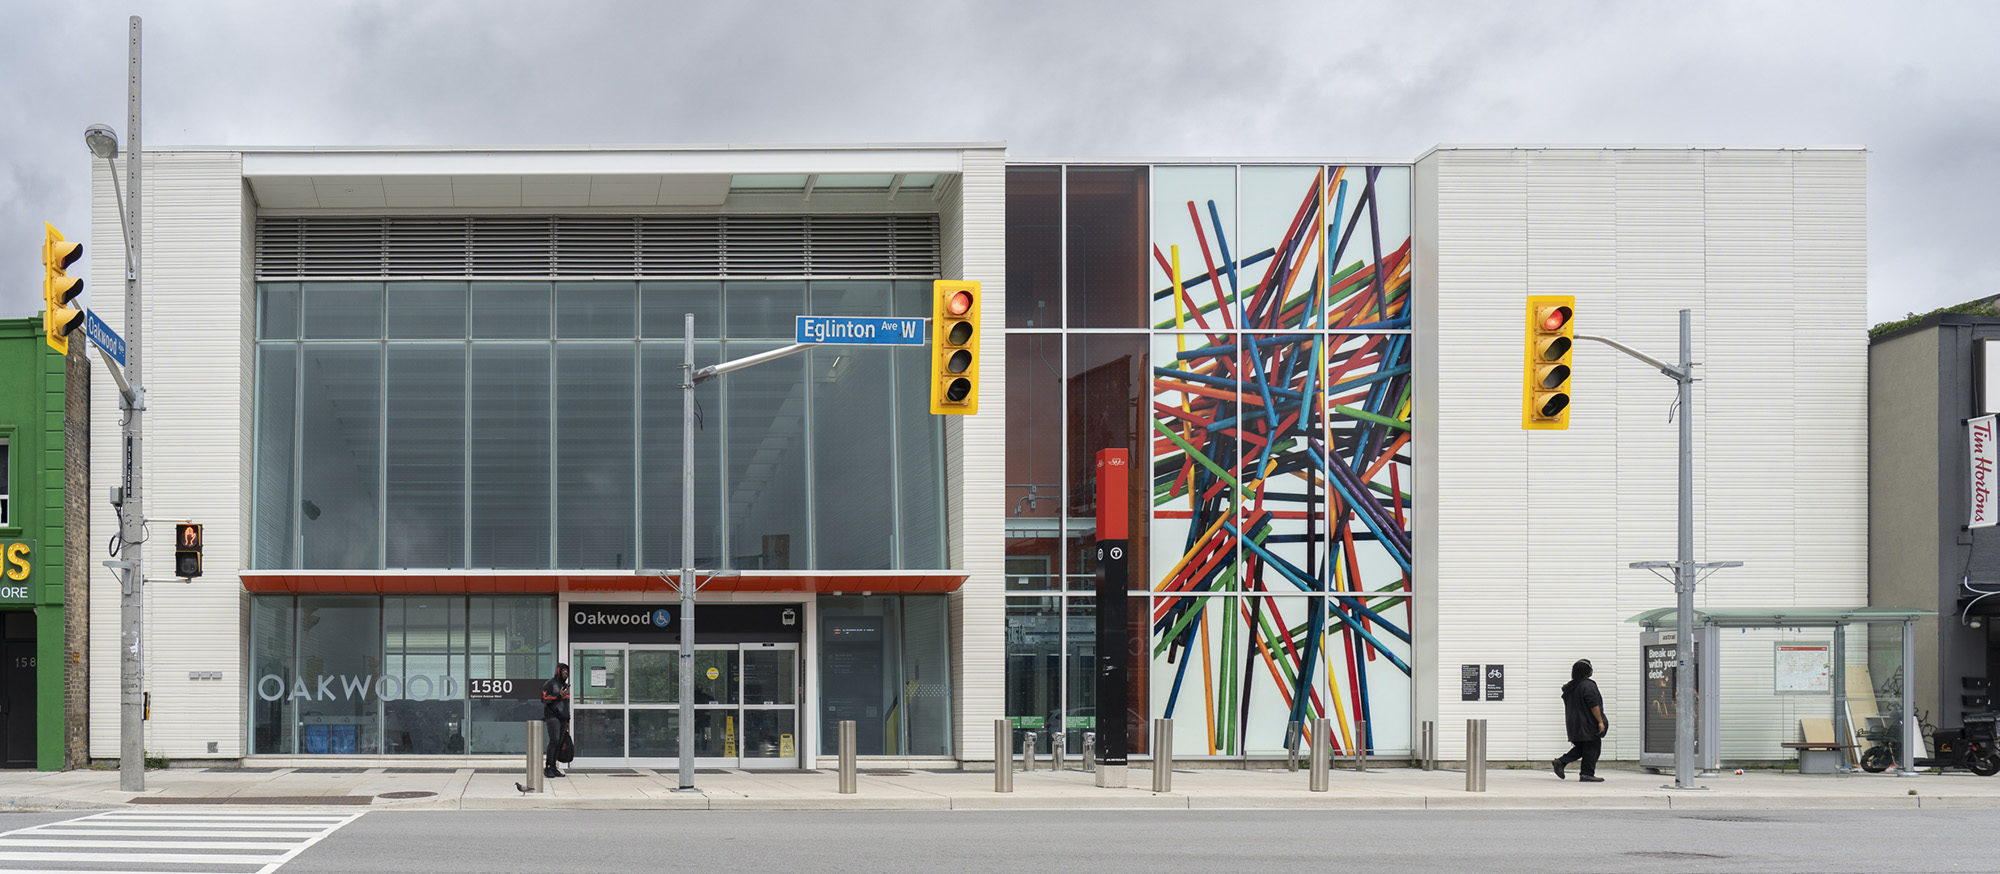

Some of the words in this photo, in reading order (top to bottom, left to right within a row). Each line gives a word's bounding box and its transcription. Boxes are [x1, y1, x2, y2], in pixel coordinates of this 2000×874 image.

[89, 316, 117, 355] Oakwood
[804, 319, 875, 342] Eglinton
[881, 321, 898, 331] Ave
[900, 321, 916, 338] W
[1973, 420, 1992, 453] Tim
[1975, 456, 1993, 522] Hortons
[0, 542, 31, 581] S
[0, 586, 28, 598] ORE
[574, 611, 651, 625] Oakwood
[1649, 648, 1666, 658] Break
[1667, 649, 1676, 660] up
[1649, 658, 1663, 668] with
[1649, 669, 1665, 679] debt.
[257, 674, 458, 701] OAKWOOD
[471, 680, 513, 693] 1580
